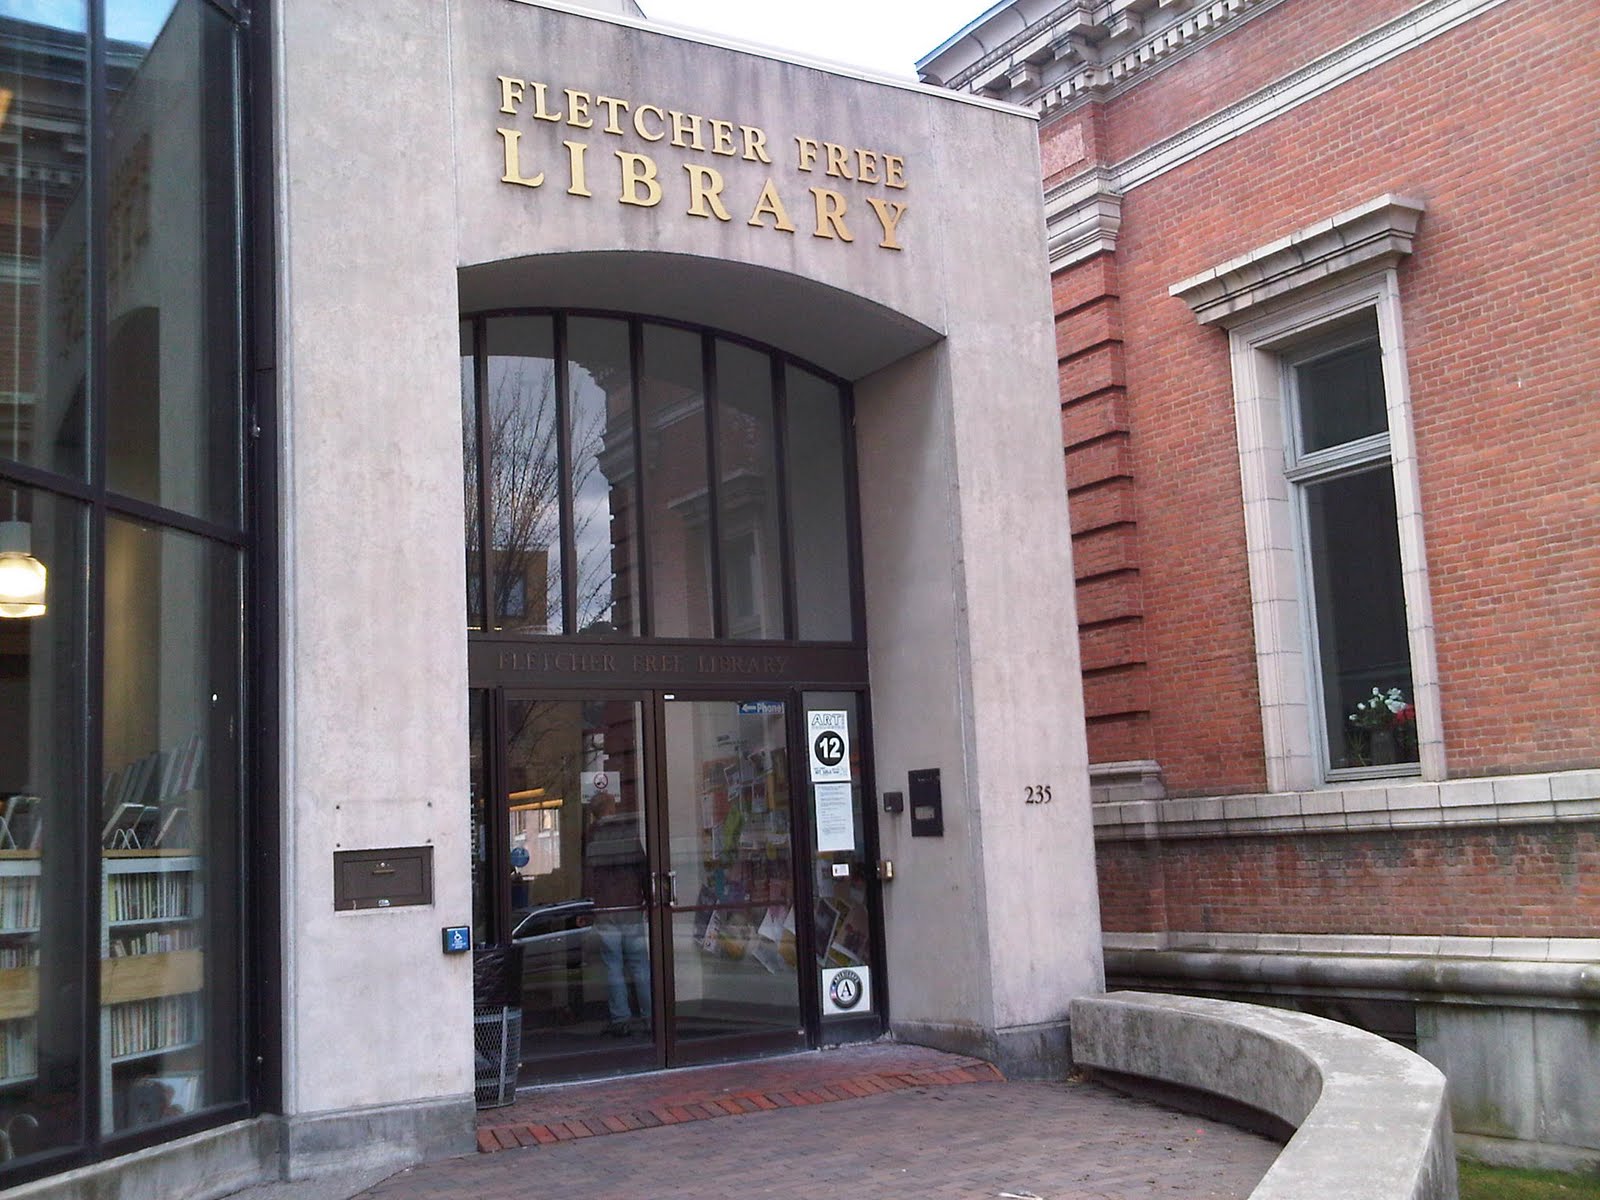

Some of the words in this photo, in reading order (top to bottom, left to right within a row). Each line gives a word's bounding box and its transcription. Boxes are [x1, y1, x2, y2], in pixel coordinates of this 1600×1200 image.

[497, 75, 772, 164] FLETCHER
[795, 135, 908, 190] FREE
[497, 127, 908, 250] LIBRARY
[499, 652, 616, 673] FLETCHER
[696, 655, 789, 674] LIBRARY
[757, 702, 783, 713] Phone
[811, 713, 842, 726] ART
[819, 736, 841, 759] 12
[1024, 785, 1052, 804] 235
[840, 980, 853, 998] A
